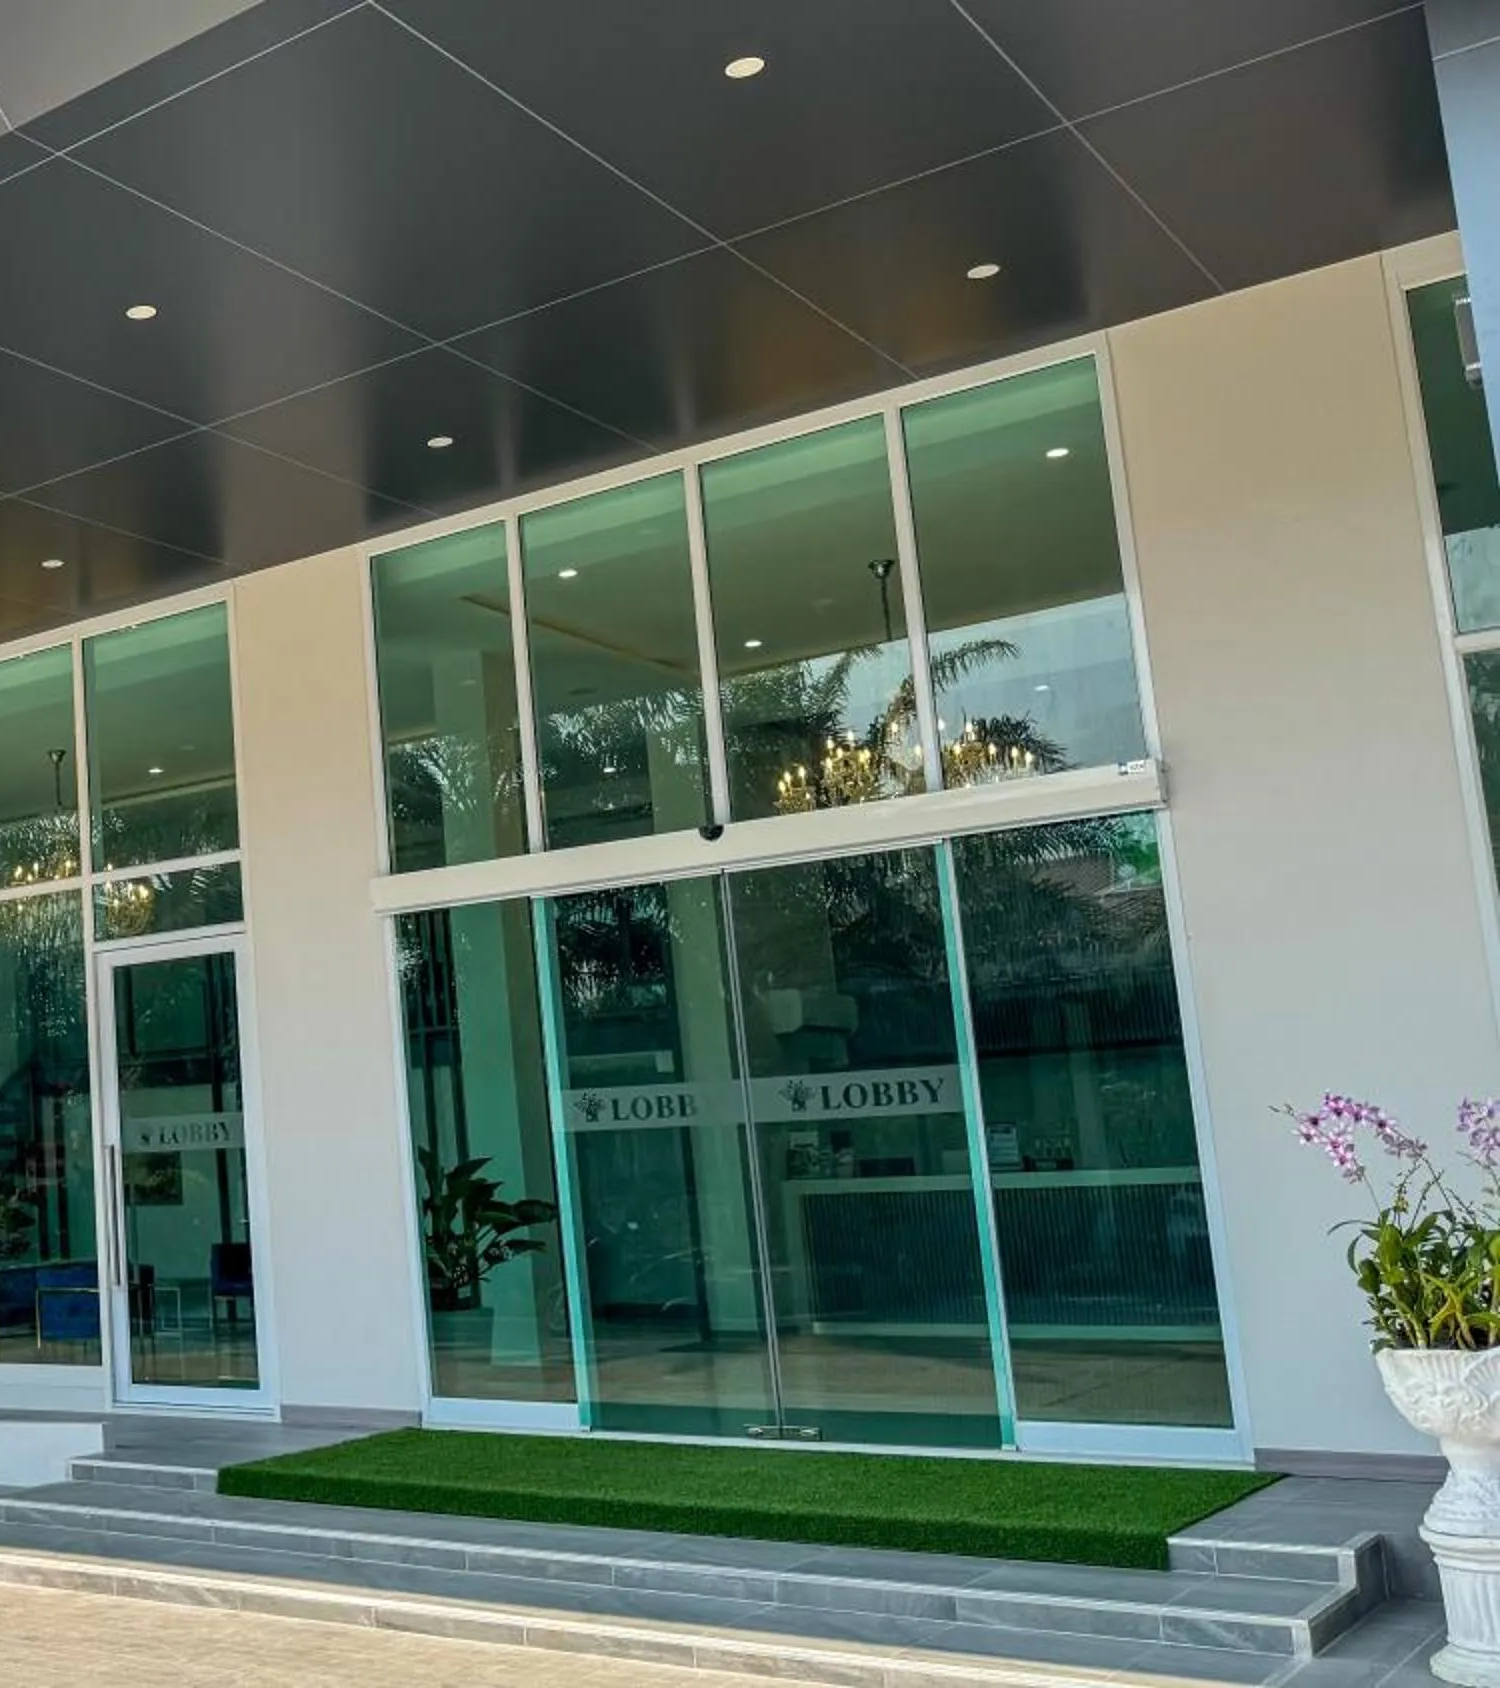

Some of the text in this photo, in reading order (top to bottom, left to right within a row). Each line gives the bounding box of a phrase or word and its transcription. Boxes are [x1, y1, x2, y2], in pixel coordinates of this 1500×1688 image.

[820, 1076, 944, 1110] LOBBY
[610, 1094, 698, 1121] LOBB
[160, 1121, 232, 1145] LOBBY
